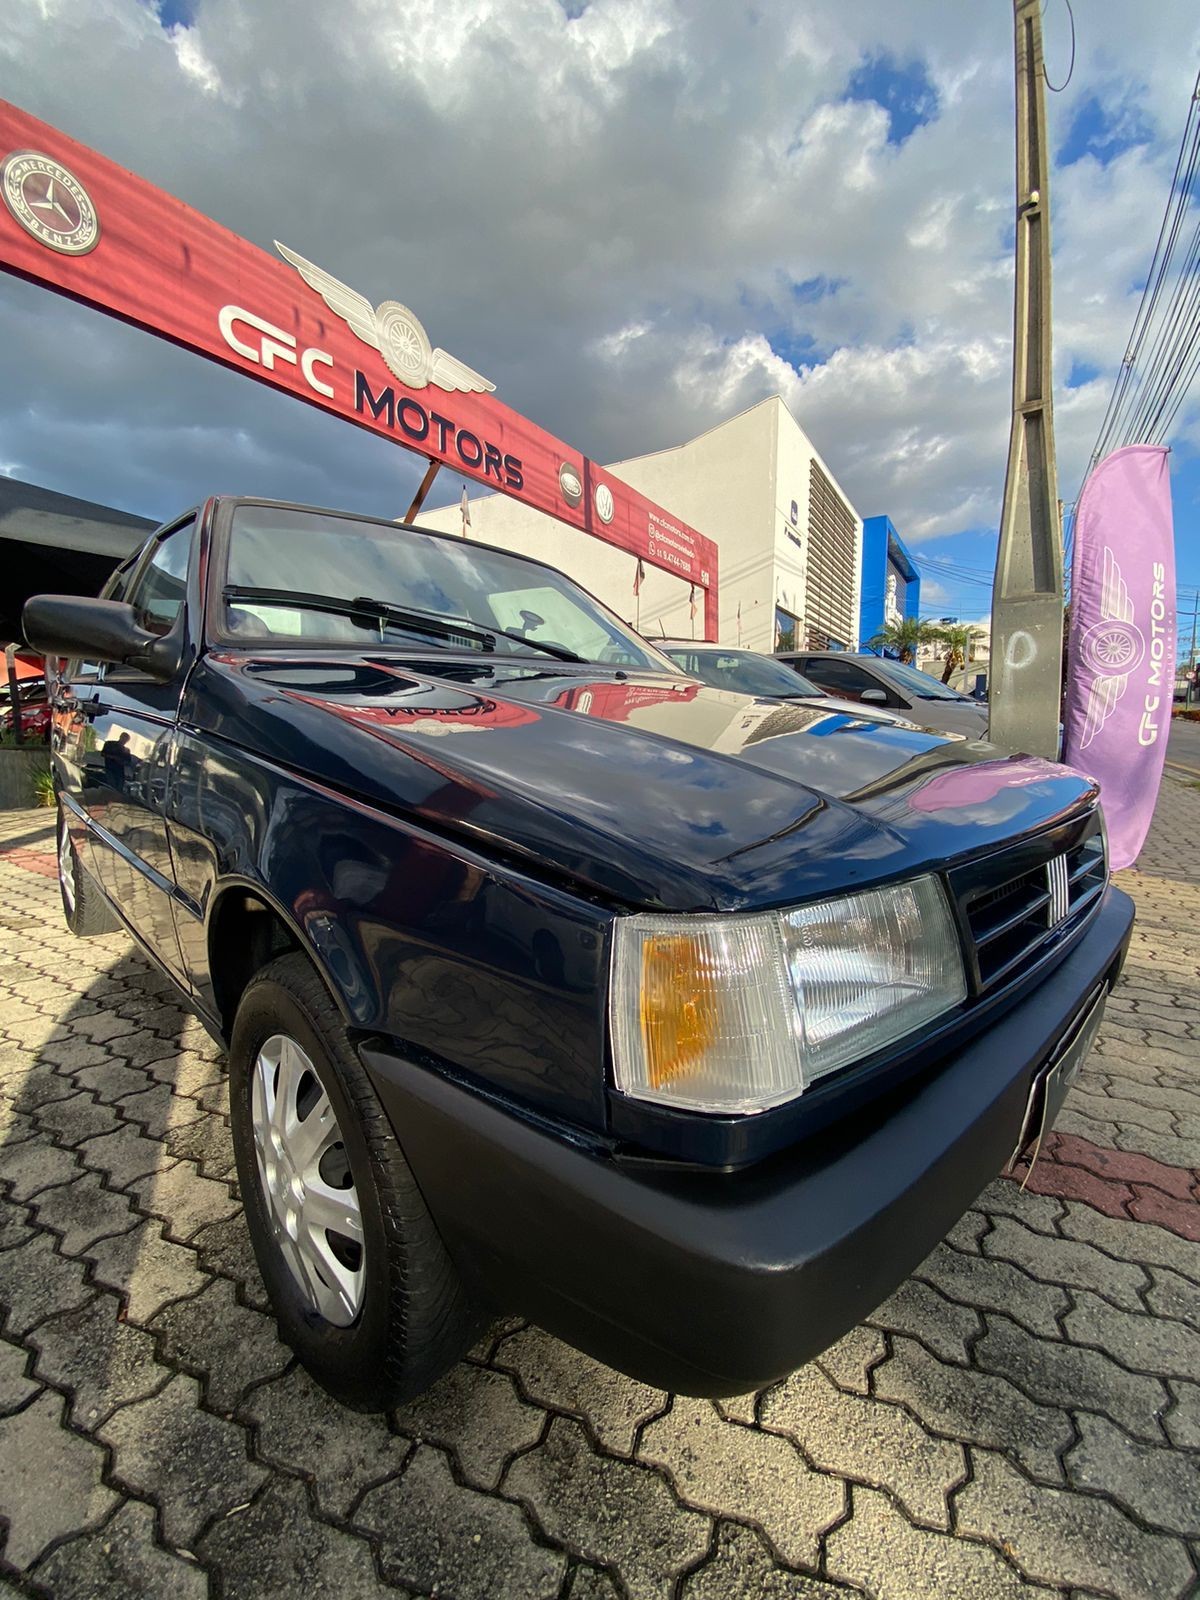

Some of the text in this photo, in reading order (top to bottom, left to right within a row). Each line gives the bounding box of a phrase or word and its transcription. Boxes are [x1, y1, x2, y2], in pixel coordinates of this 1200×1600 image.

[19, 160, 84, 202] MERCEDES
[30, 218, 74, 246] BENZ
[218, 304, 524, 491] CFC MOTORS
[1138, 562, 1165, 746] CFC MOTORS
